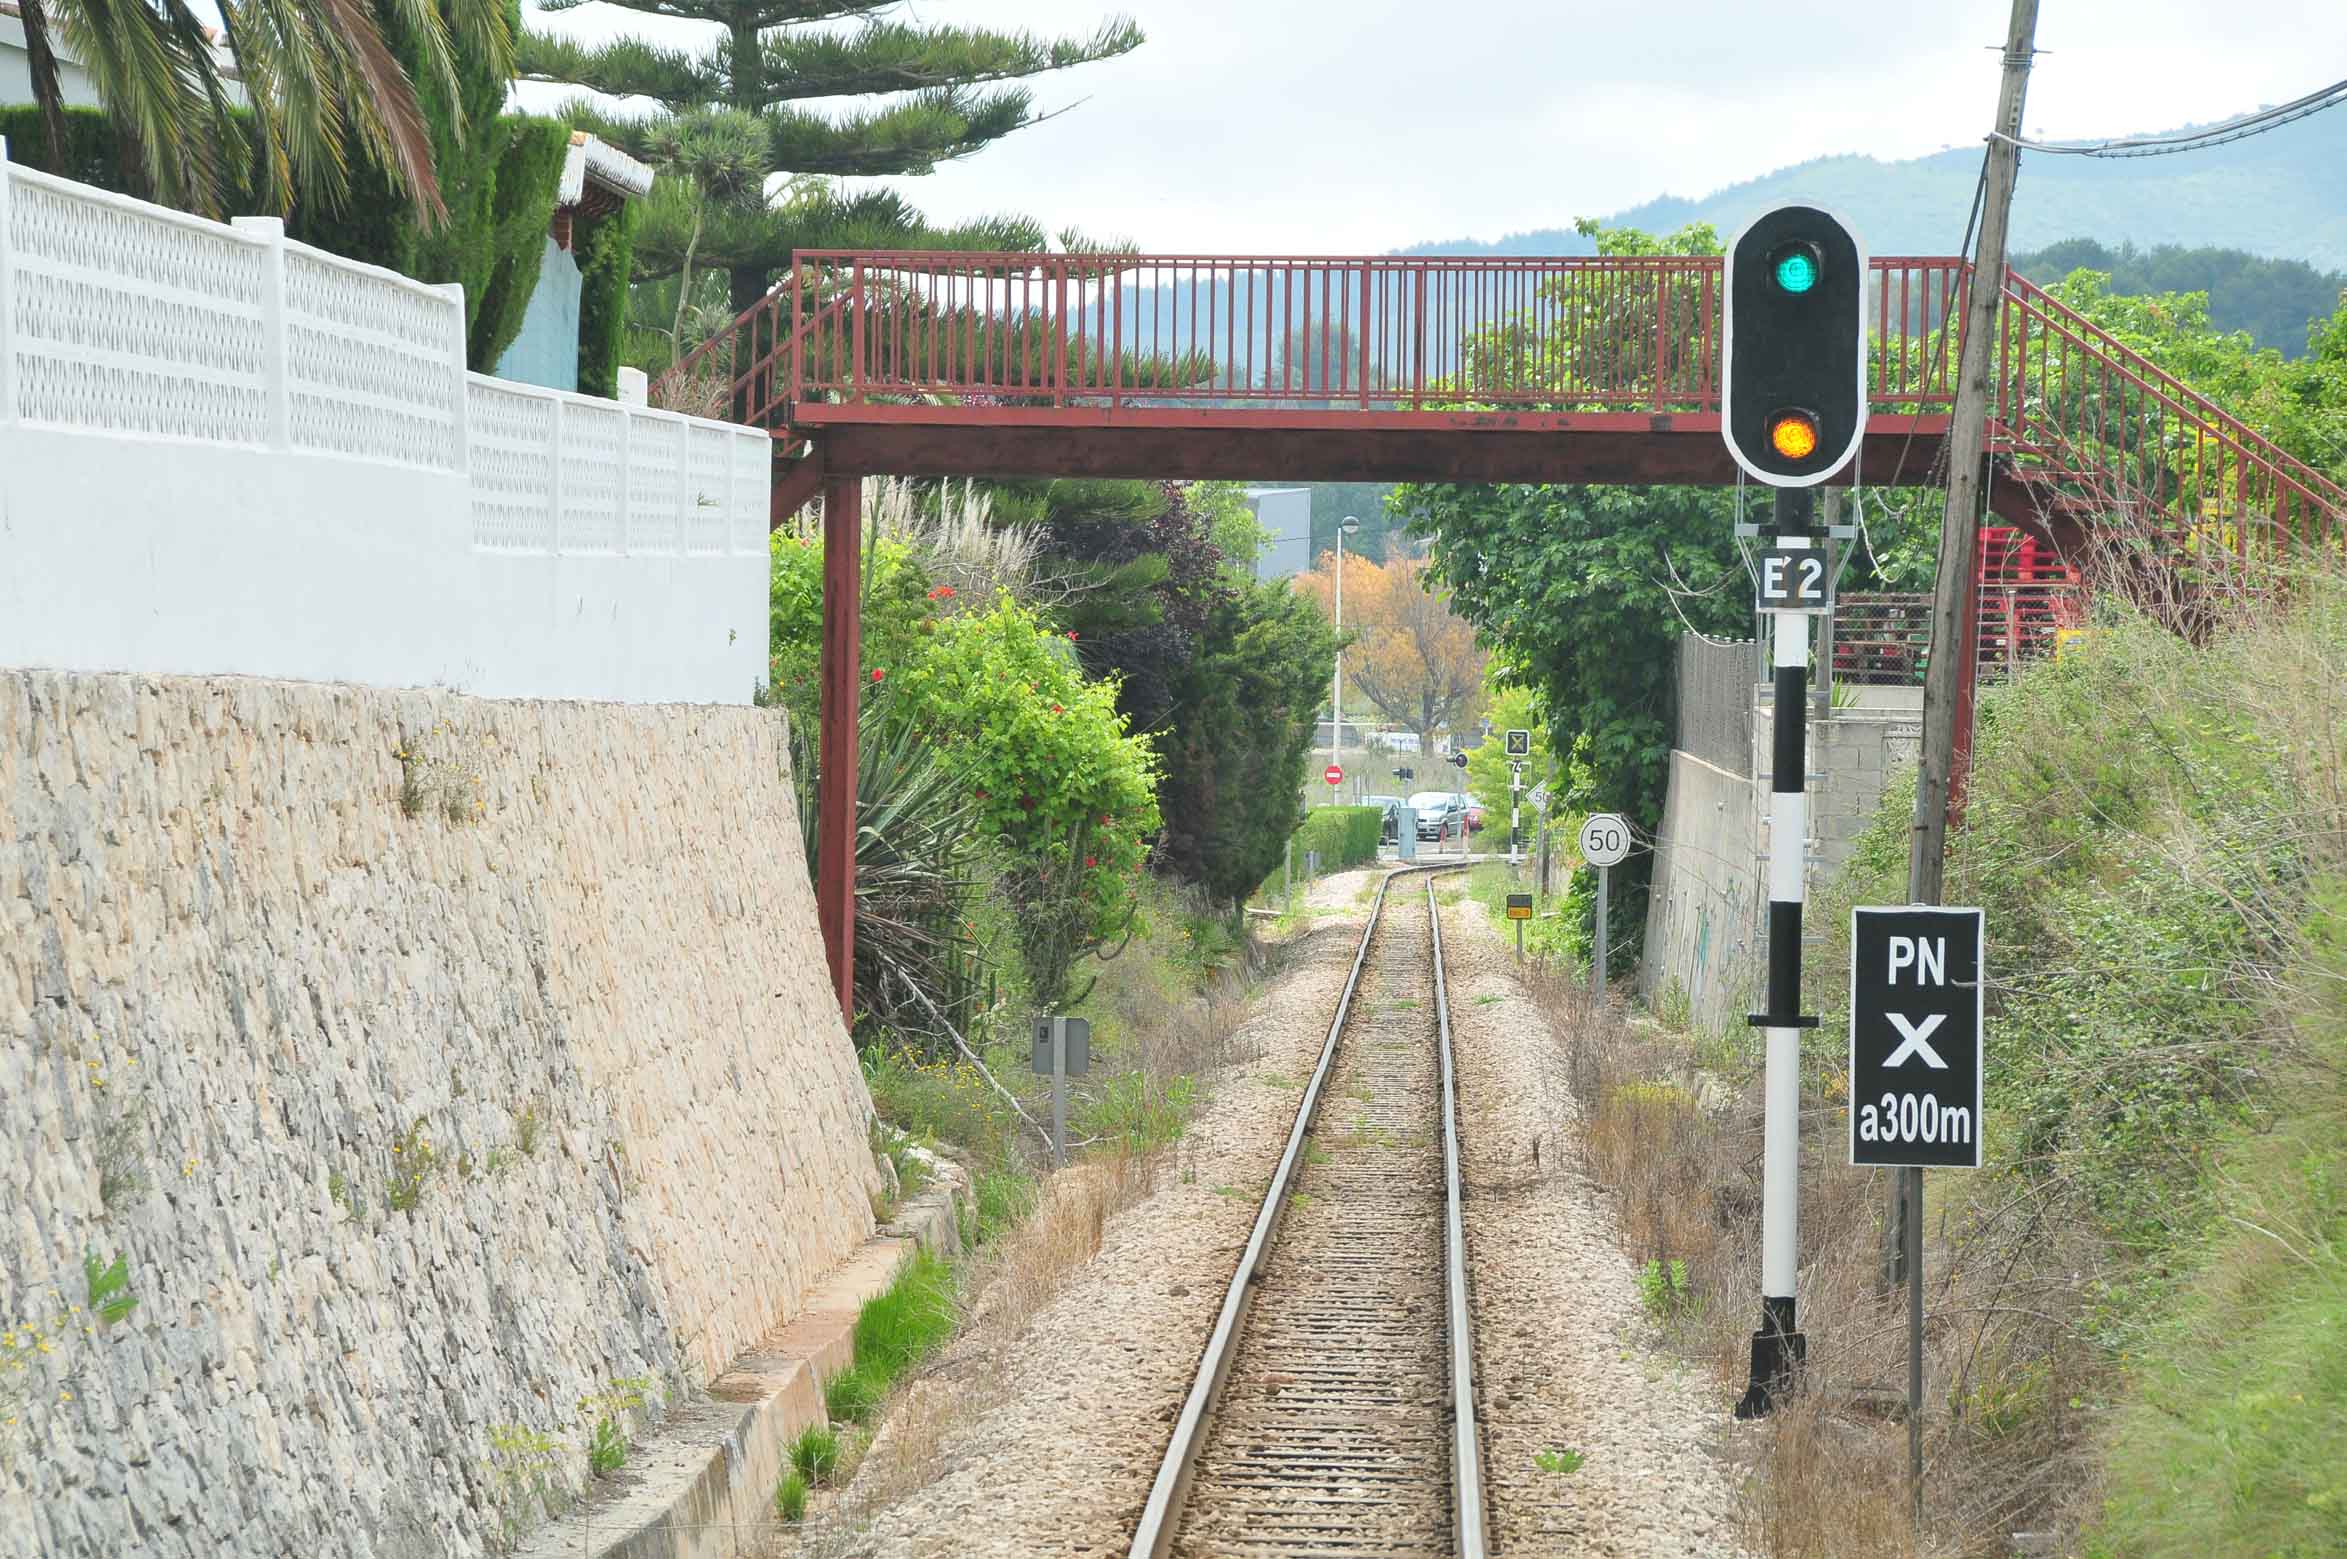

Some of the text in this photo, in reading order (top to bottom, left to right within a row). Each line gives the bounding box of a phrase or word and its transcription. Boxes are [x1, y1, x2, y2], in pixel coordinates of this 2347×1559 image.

[1590, 829, 1620, 851] 50
[1888, 936, 1946, 986] PN
[1859, 1092, 1971, 1144] a300m
